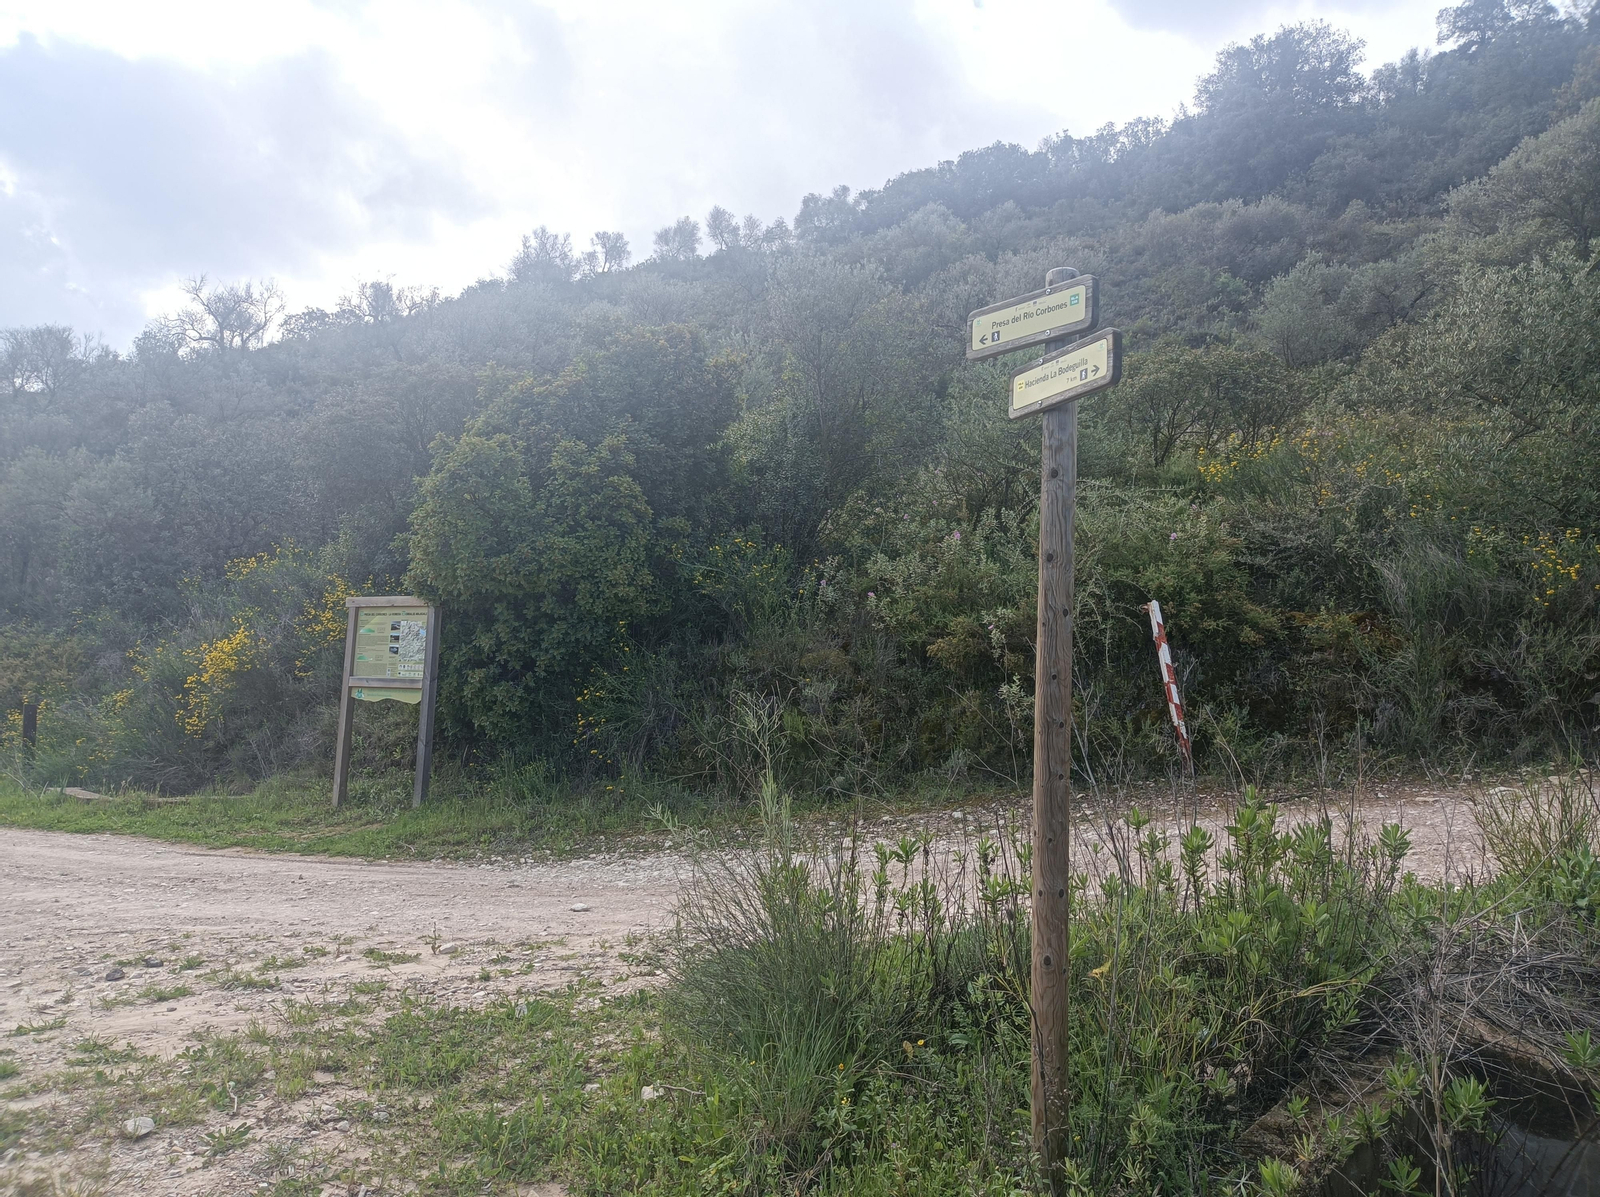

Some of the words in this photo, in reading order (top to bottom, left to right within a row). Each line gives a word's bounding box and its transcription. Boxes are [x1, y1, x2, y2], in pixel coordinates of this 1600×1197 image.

[991, 319, 1010, 330] Presa
[1011, 313, 1021, 324] del
[1023, 311, 1035, 321] Río
[1035, 301, 1068, 317] Corbones
[1024, 373, 1049, 389] Hacienda
[1050, 370, 1057, 379] La
[1058, 357, 1088, 377] Bodeguilla
